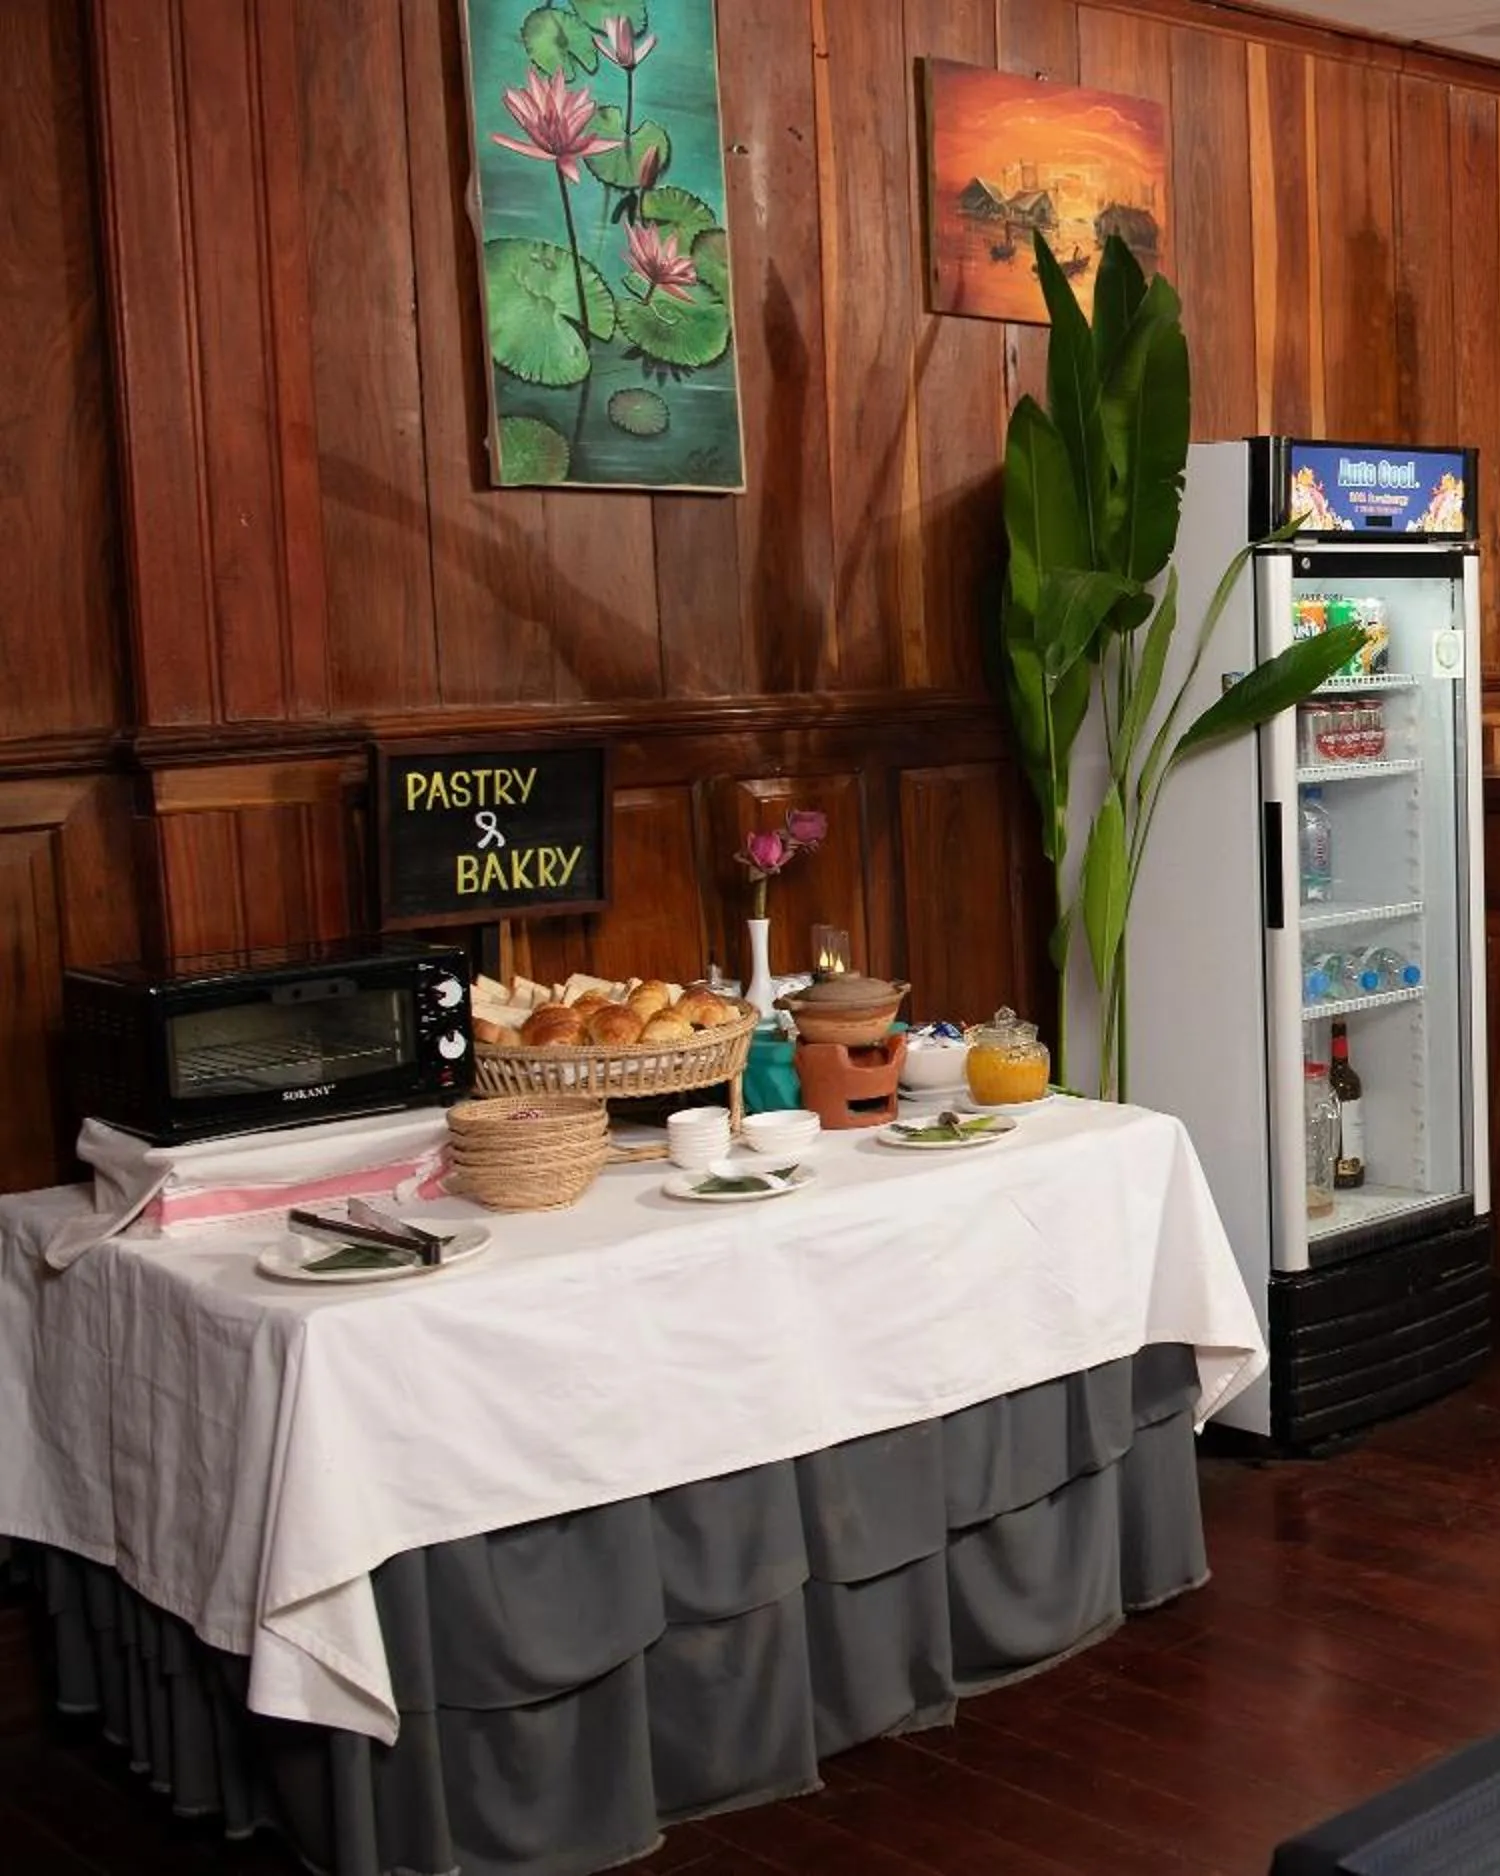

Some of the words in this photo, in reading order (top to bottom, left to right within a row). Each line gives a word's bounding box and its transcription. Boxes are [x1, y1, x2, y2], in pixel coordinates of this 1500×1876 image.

[405, 767, 538, 811] PASTRY
[474, 811, 506, 849] &
[456, 846, 582, 895] BAKRY
